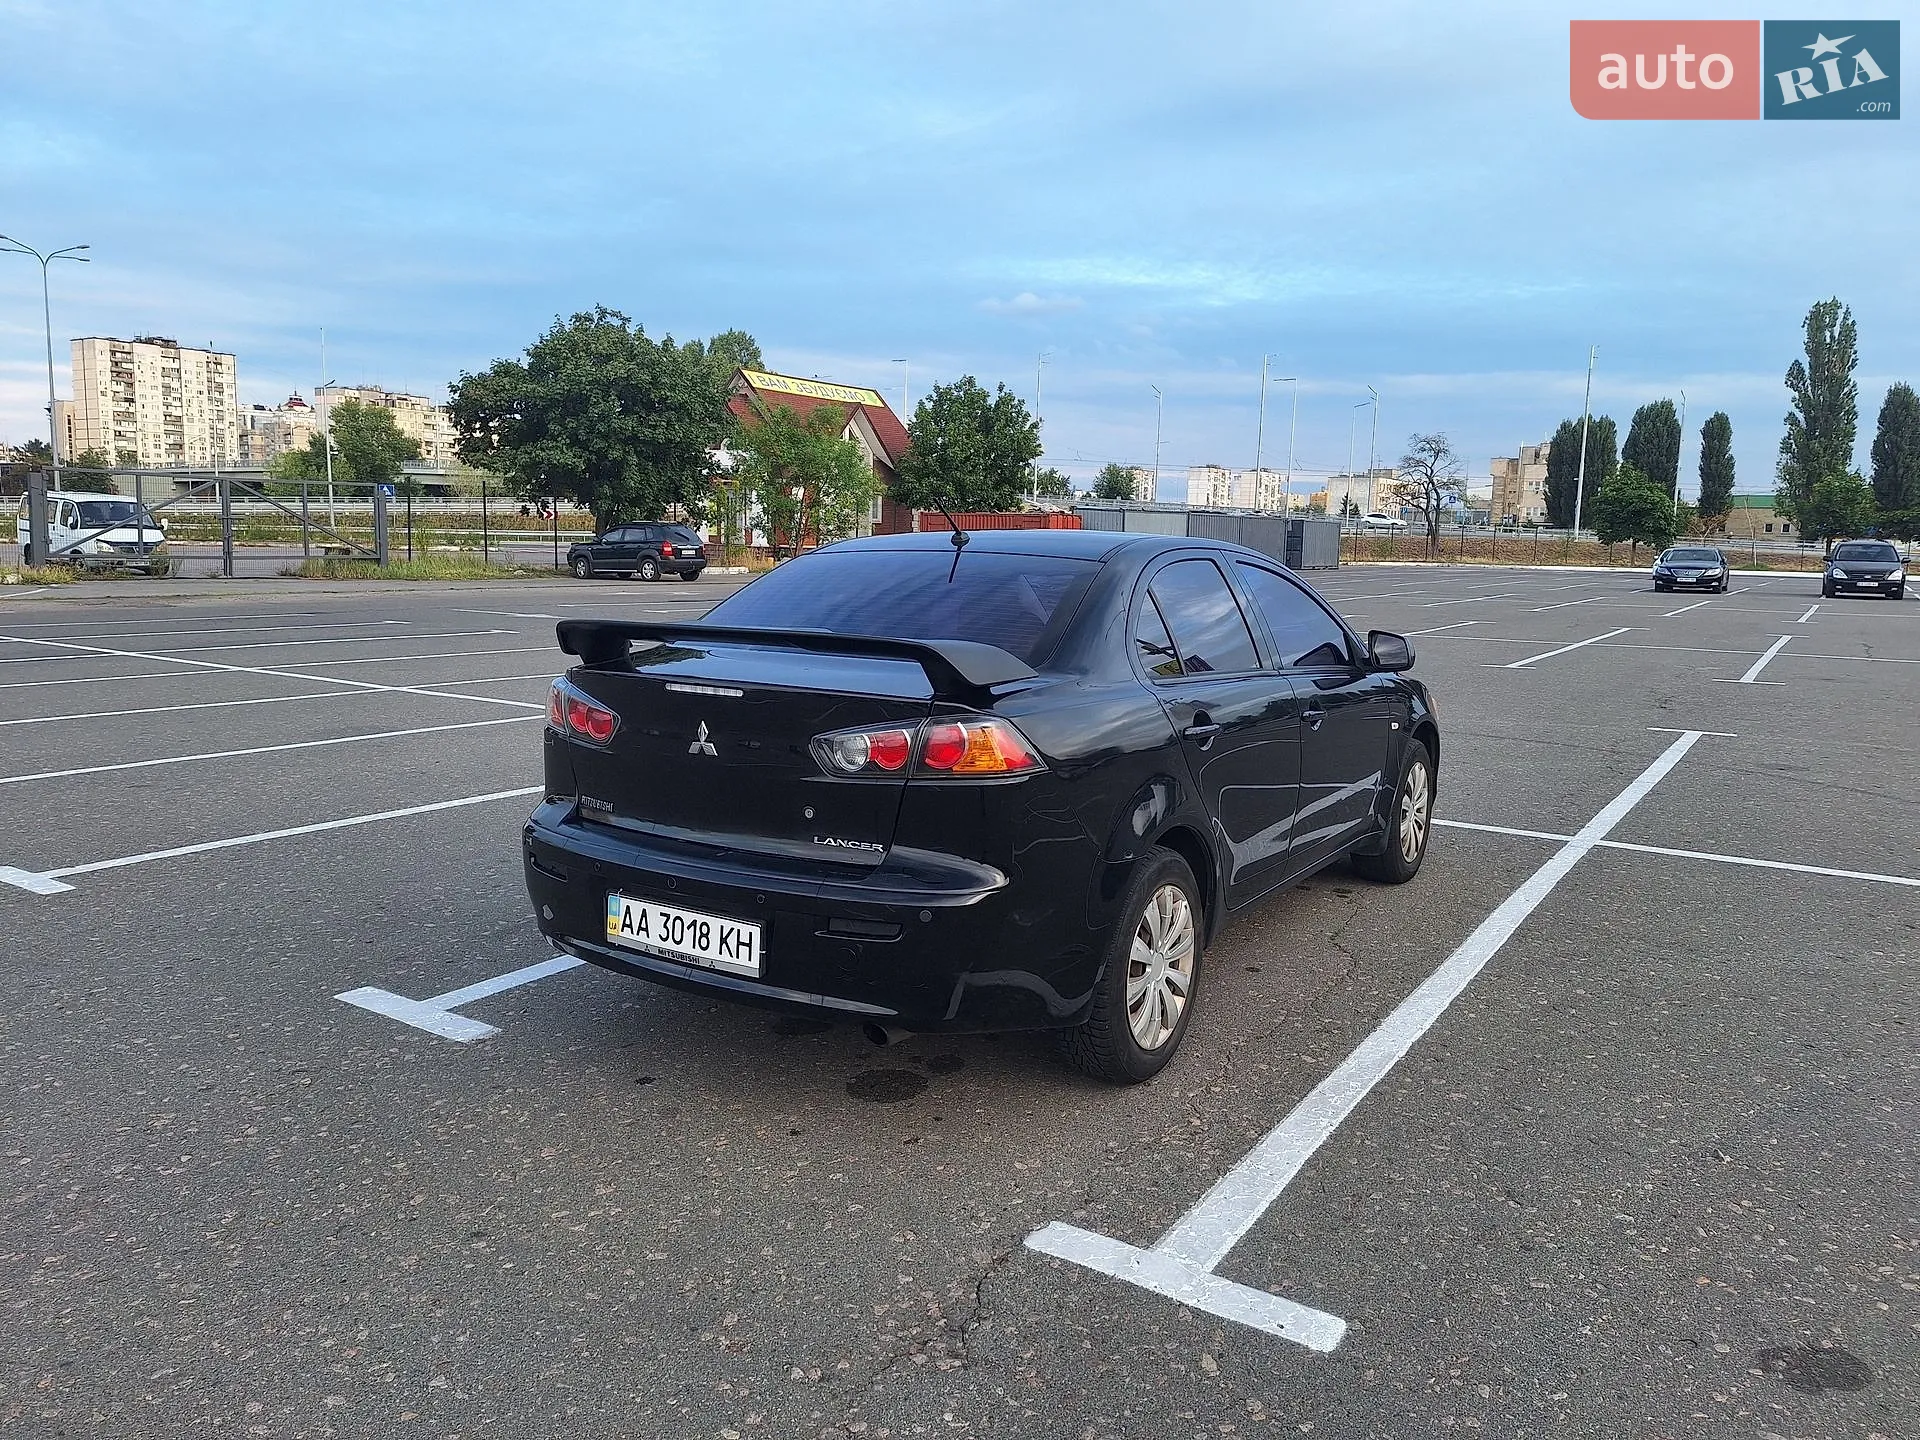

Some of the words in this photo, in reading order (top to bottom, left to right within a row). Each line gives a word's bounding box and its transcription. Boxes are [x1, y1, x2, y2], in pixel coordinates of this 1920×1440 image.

[757, 375, 792, 391] ВАМ
[792, 382, 866, 401] ЗБУДУЄМО
[813, 836, 884, 853] LANCER
[608, 921, 618, 930] UA
[620, 904, 650, 939] AA
[658, 911, 711, 952] 3018
[718, 924, 754, 962] KH
[657, 948, 700, 965] MITSUBISHI
